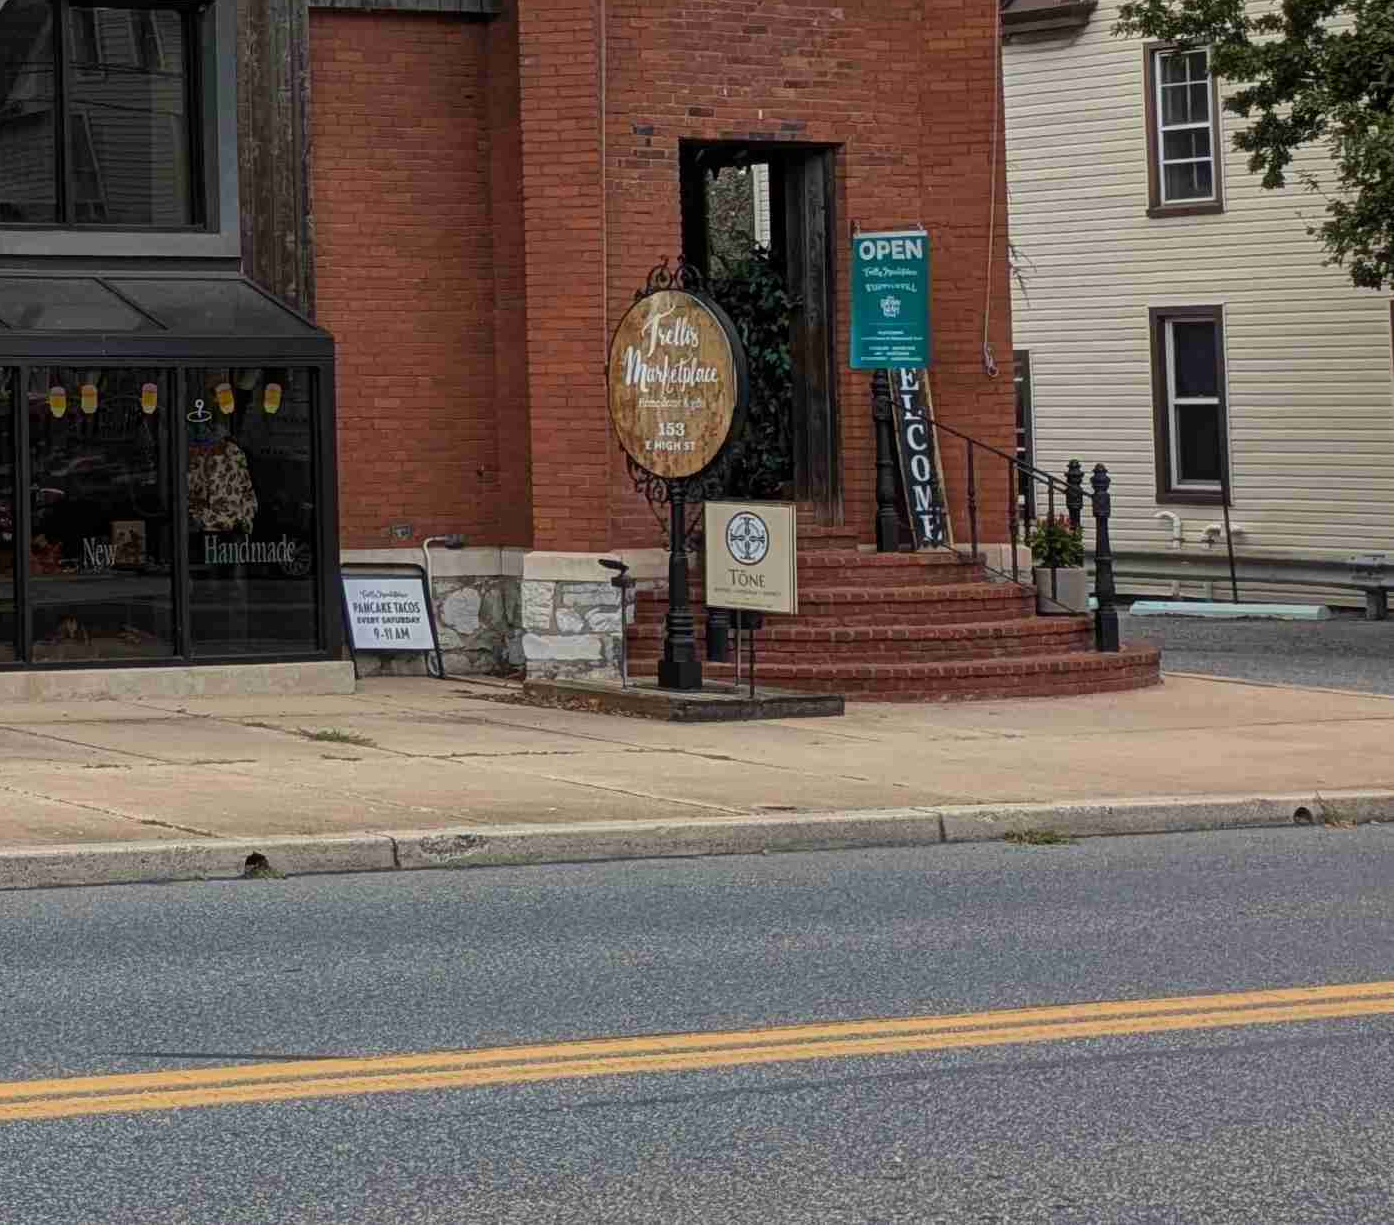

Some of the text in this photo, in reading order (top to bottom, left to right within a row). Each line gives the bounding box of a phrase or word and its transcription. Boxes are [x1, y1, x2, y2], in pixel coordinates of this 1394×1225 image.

[858, 238, 924, 261] OPEN
[640, 303, 699, 358] Trellis
[622, 344, 719, 394] Marketplace
[658, 421, 685, 437] 153
[644, 440, 696, 452] E HIGH ST
[899, 366, 944, 543] ELCOME
[82, 536, 118, 567] New
[204, 533, 296, 565] Handmade
[352, 601, 421, 614] PANCAKE TACOS
[356, 616, 421, 625] EVERY SATURDAY
[395, 627, 411, 640] AM
